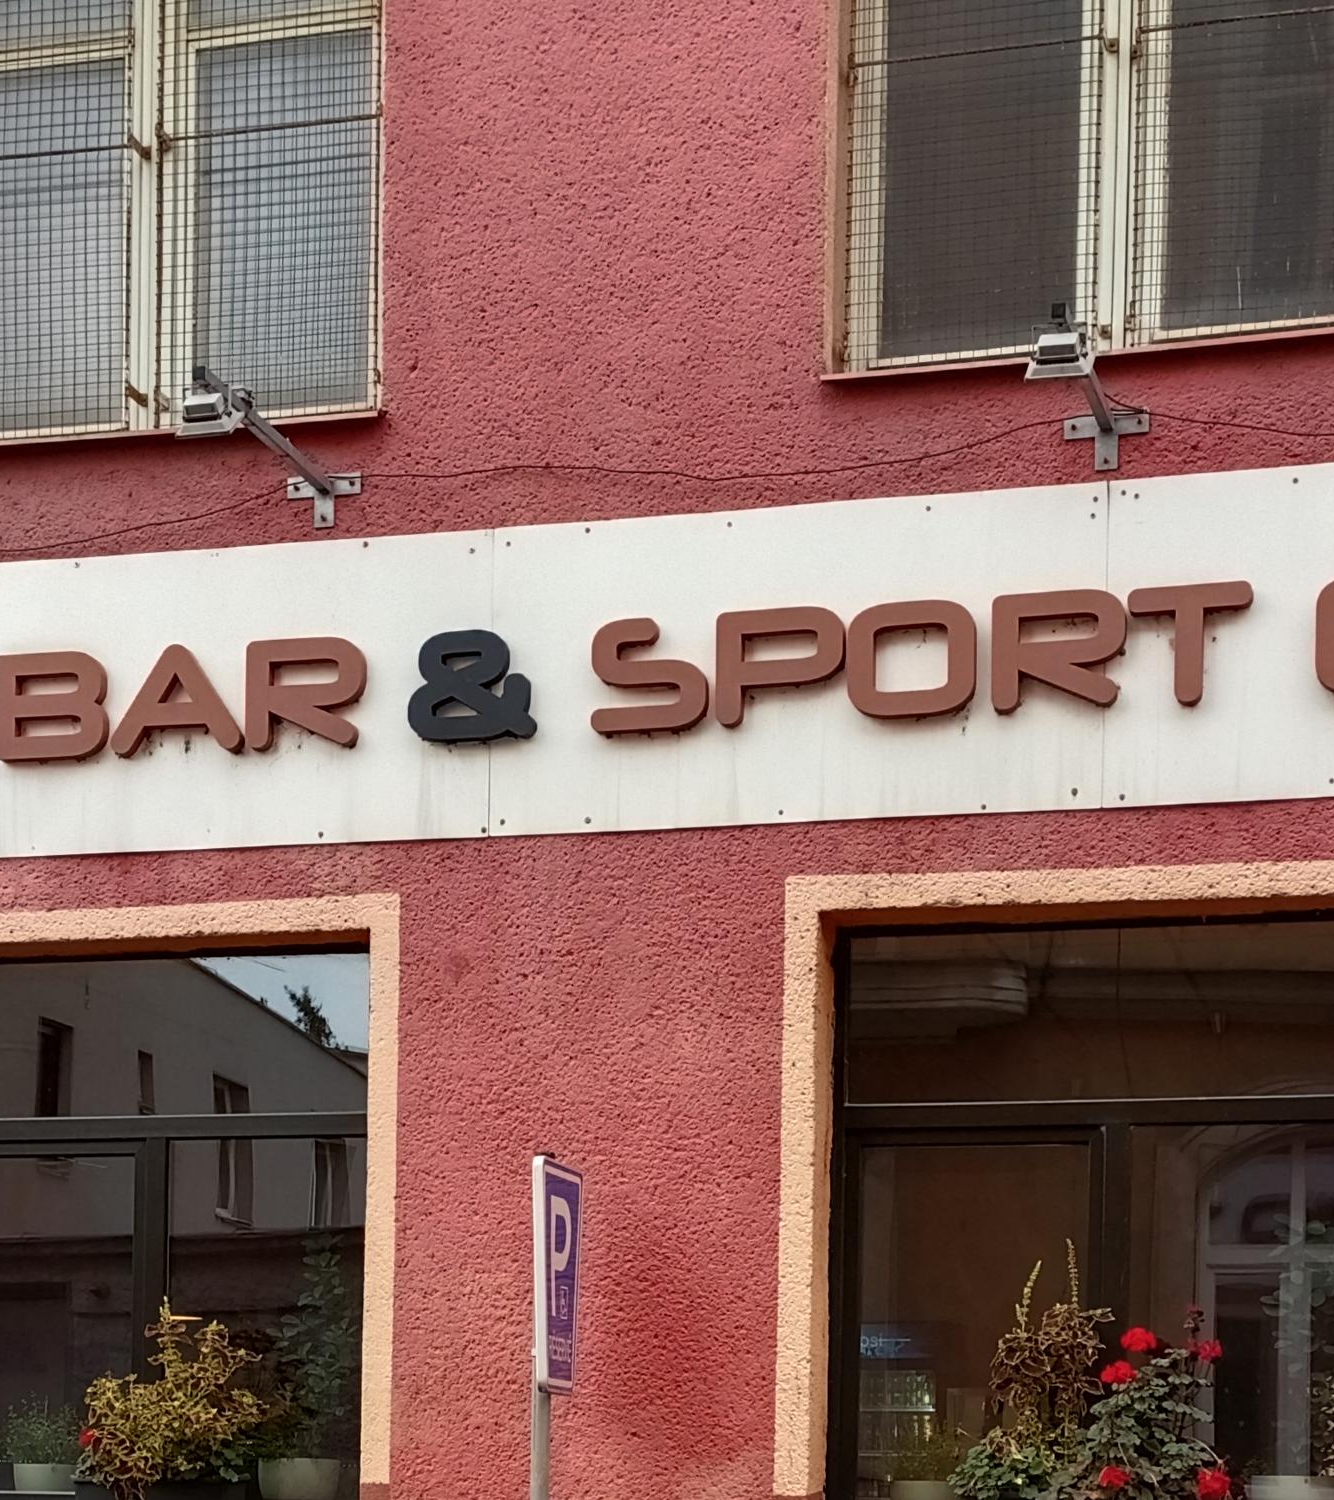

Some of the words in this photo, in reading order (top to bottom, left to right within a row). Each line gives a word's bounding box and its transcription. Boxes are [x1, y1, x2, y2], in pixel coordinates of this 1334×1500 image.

[405, 627, 539, 744] &
[589, 579, 1256, 739] SPORT
[550, 1194, 572, 1317] P
